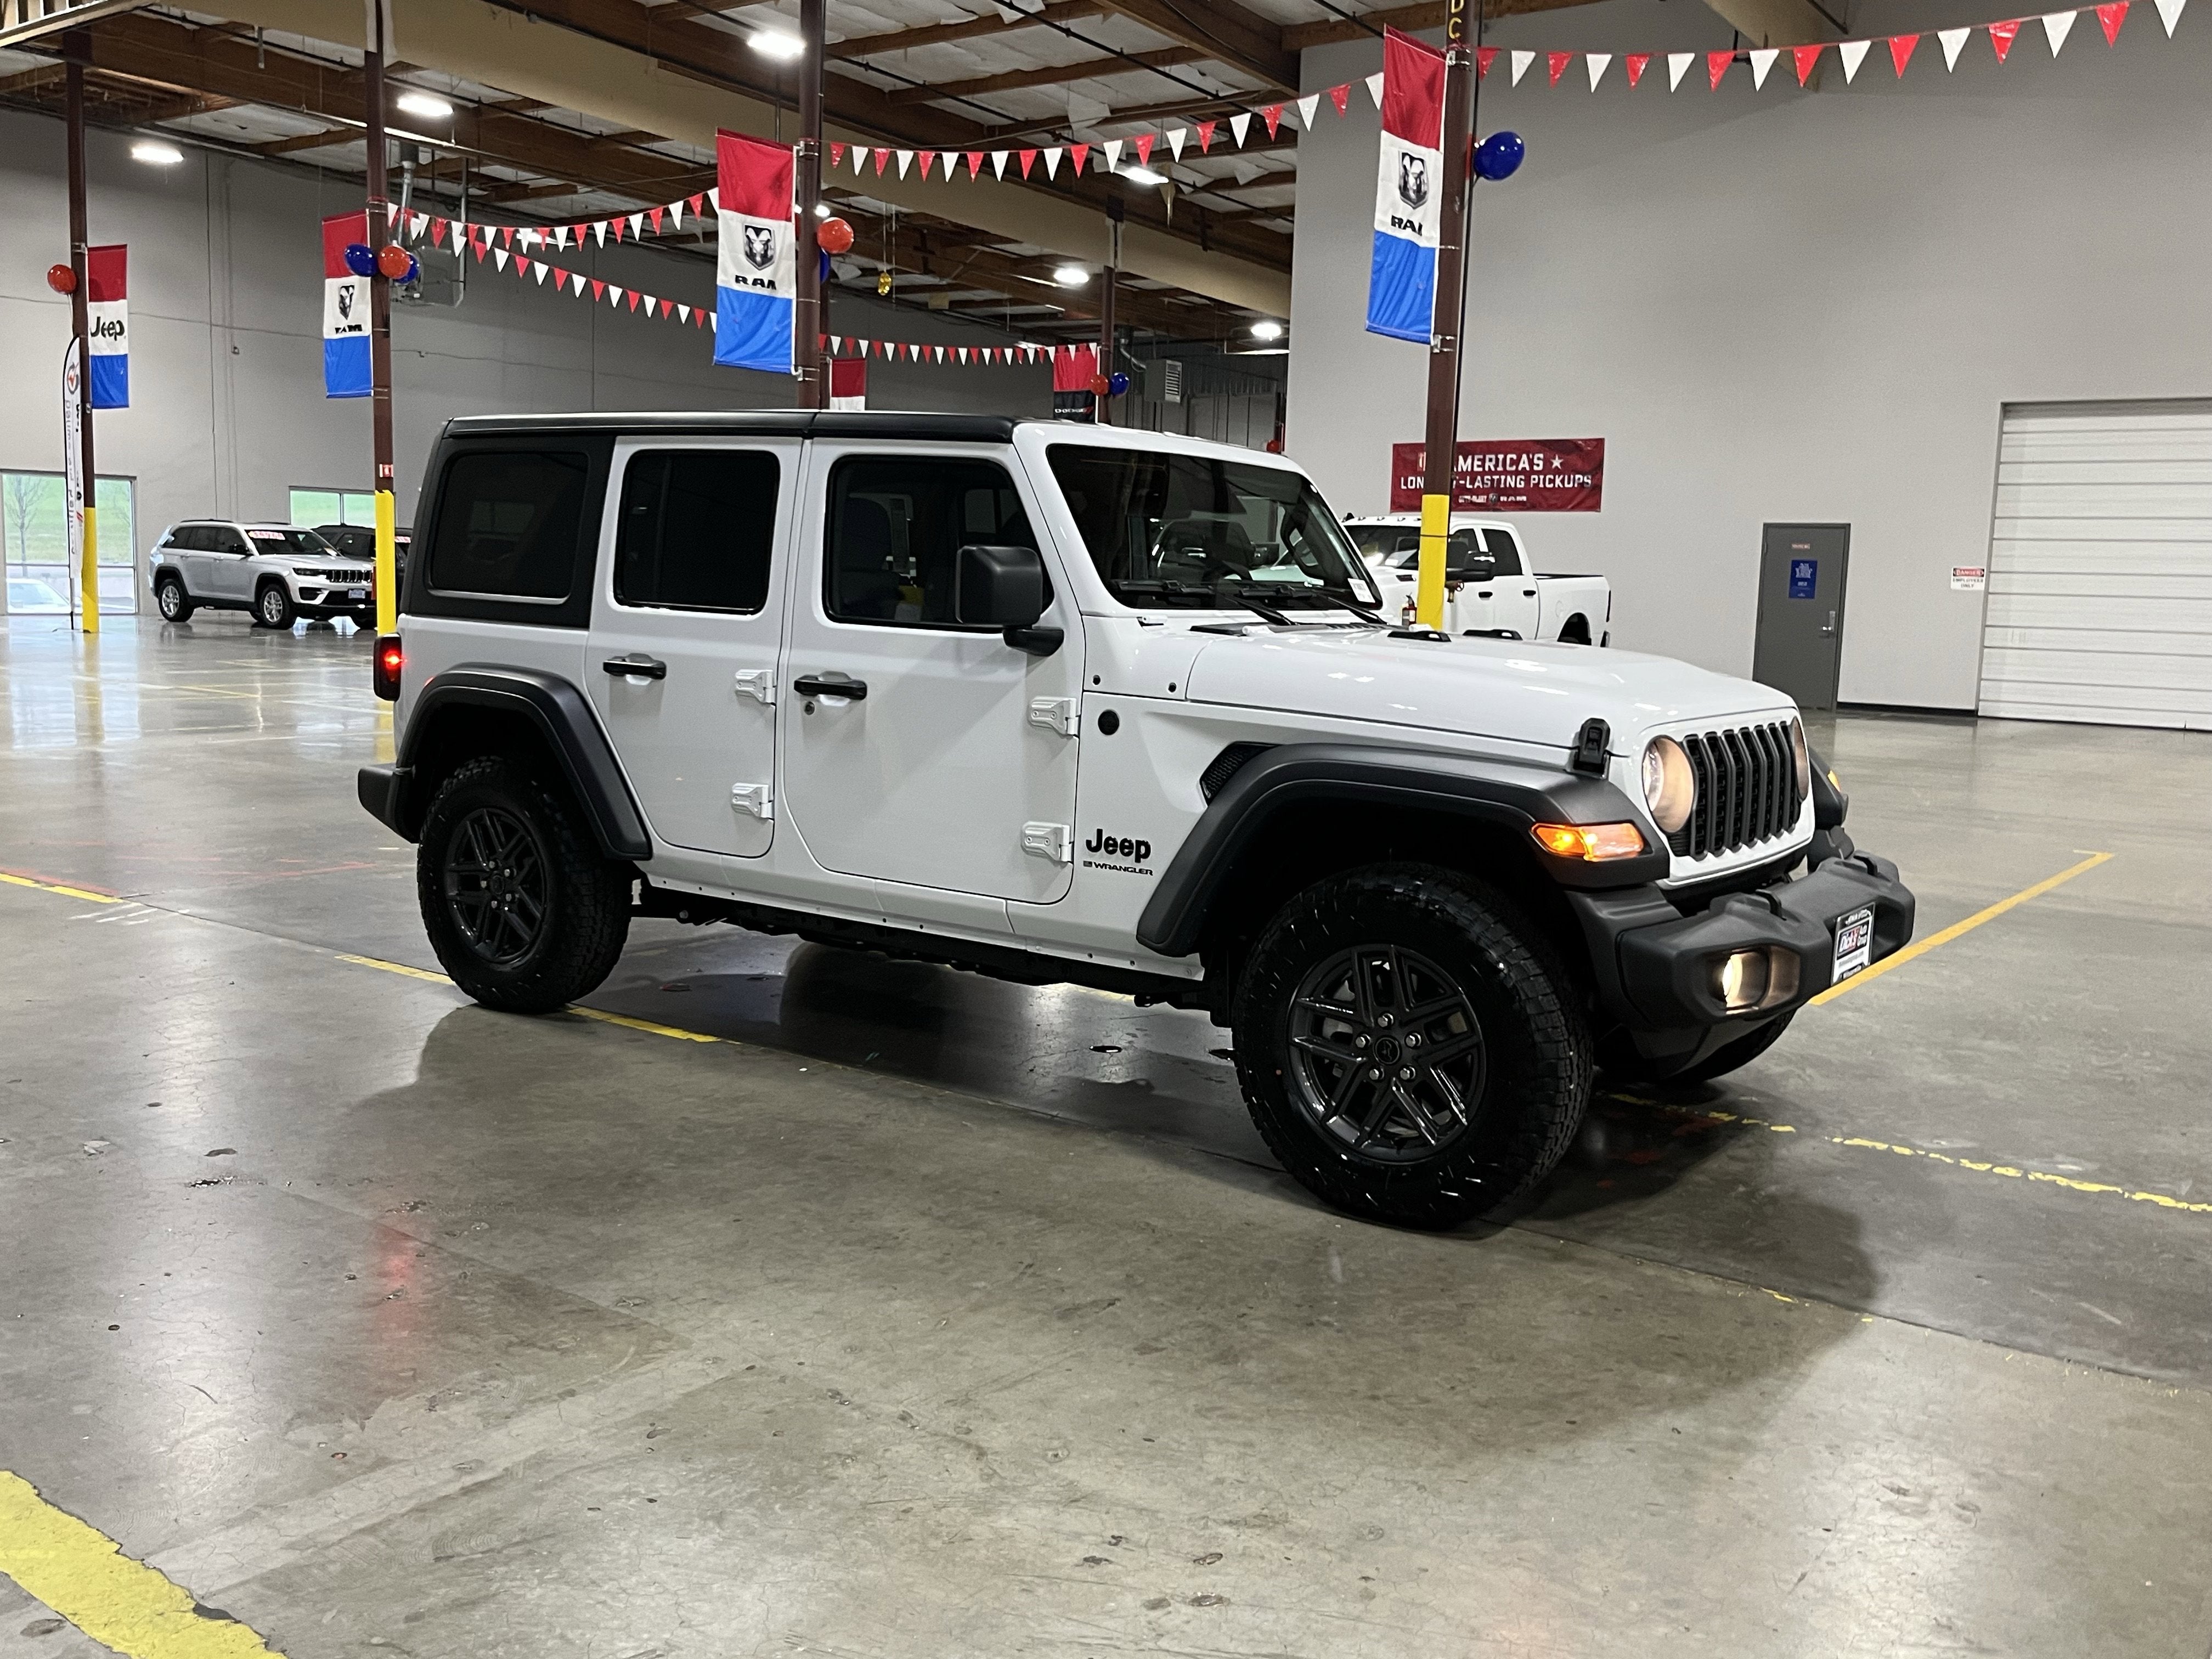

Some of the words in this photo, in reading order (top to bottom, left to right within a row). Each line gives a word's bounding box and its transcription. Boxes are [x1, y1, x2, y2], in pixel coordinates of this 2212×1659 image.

[1391, 215, 1423, 236] RA
[89, 316, 125, 341] Jeep
[1453, 453, 1544, 472] MERICA'S
[1401, 475, 1525, 489] LON-LASTING
[1530, 475, 1592, 488] PICKUPS
[1086, 828, 1152, 864] Jeep
[1093, 861, 1153, 876] WRANGLER
